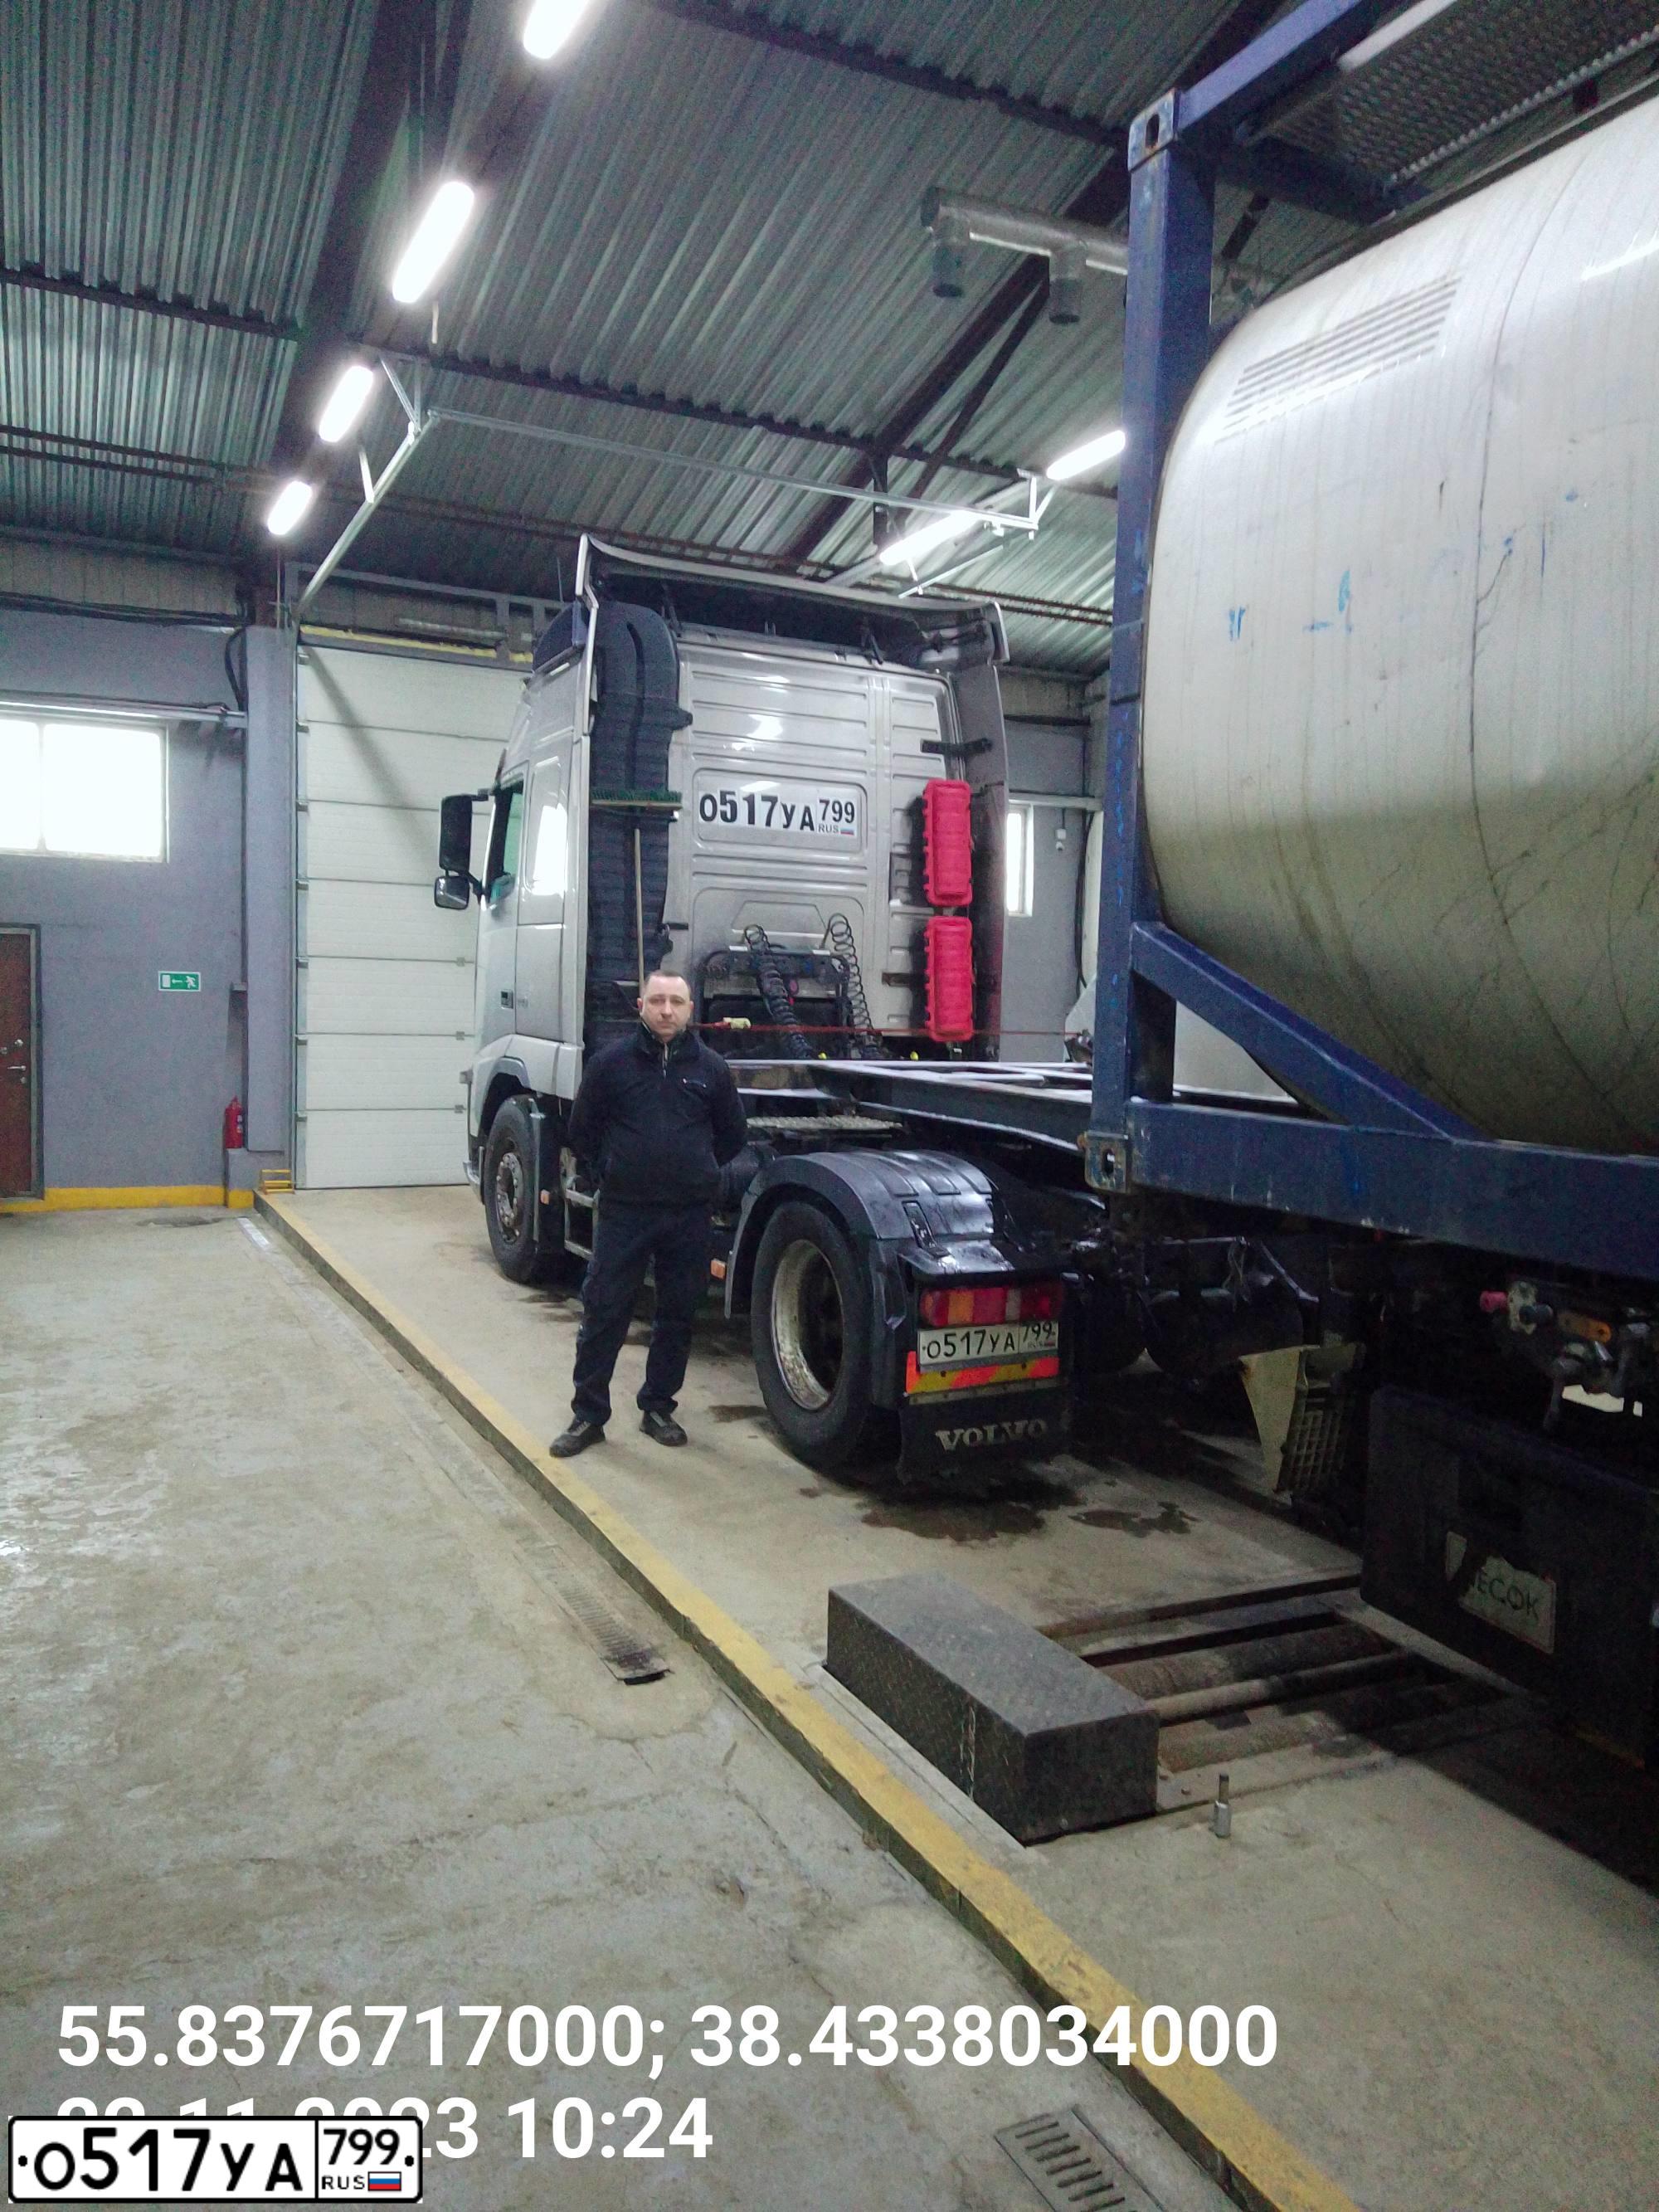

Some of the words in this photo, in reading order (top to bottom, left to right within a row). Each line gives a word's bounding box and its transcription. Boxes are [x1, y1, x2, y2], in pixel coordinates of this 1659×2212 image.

[819, 798, 854, 823] 799
[818, 823, 839, 833] RUS
[935, 1419, 1048, 1451] VOLVO
